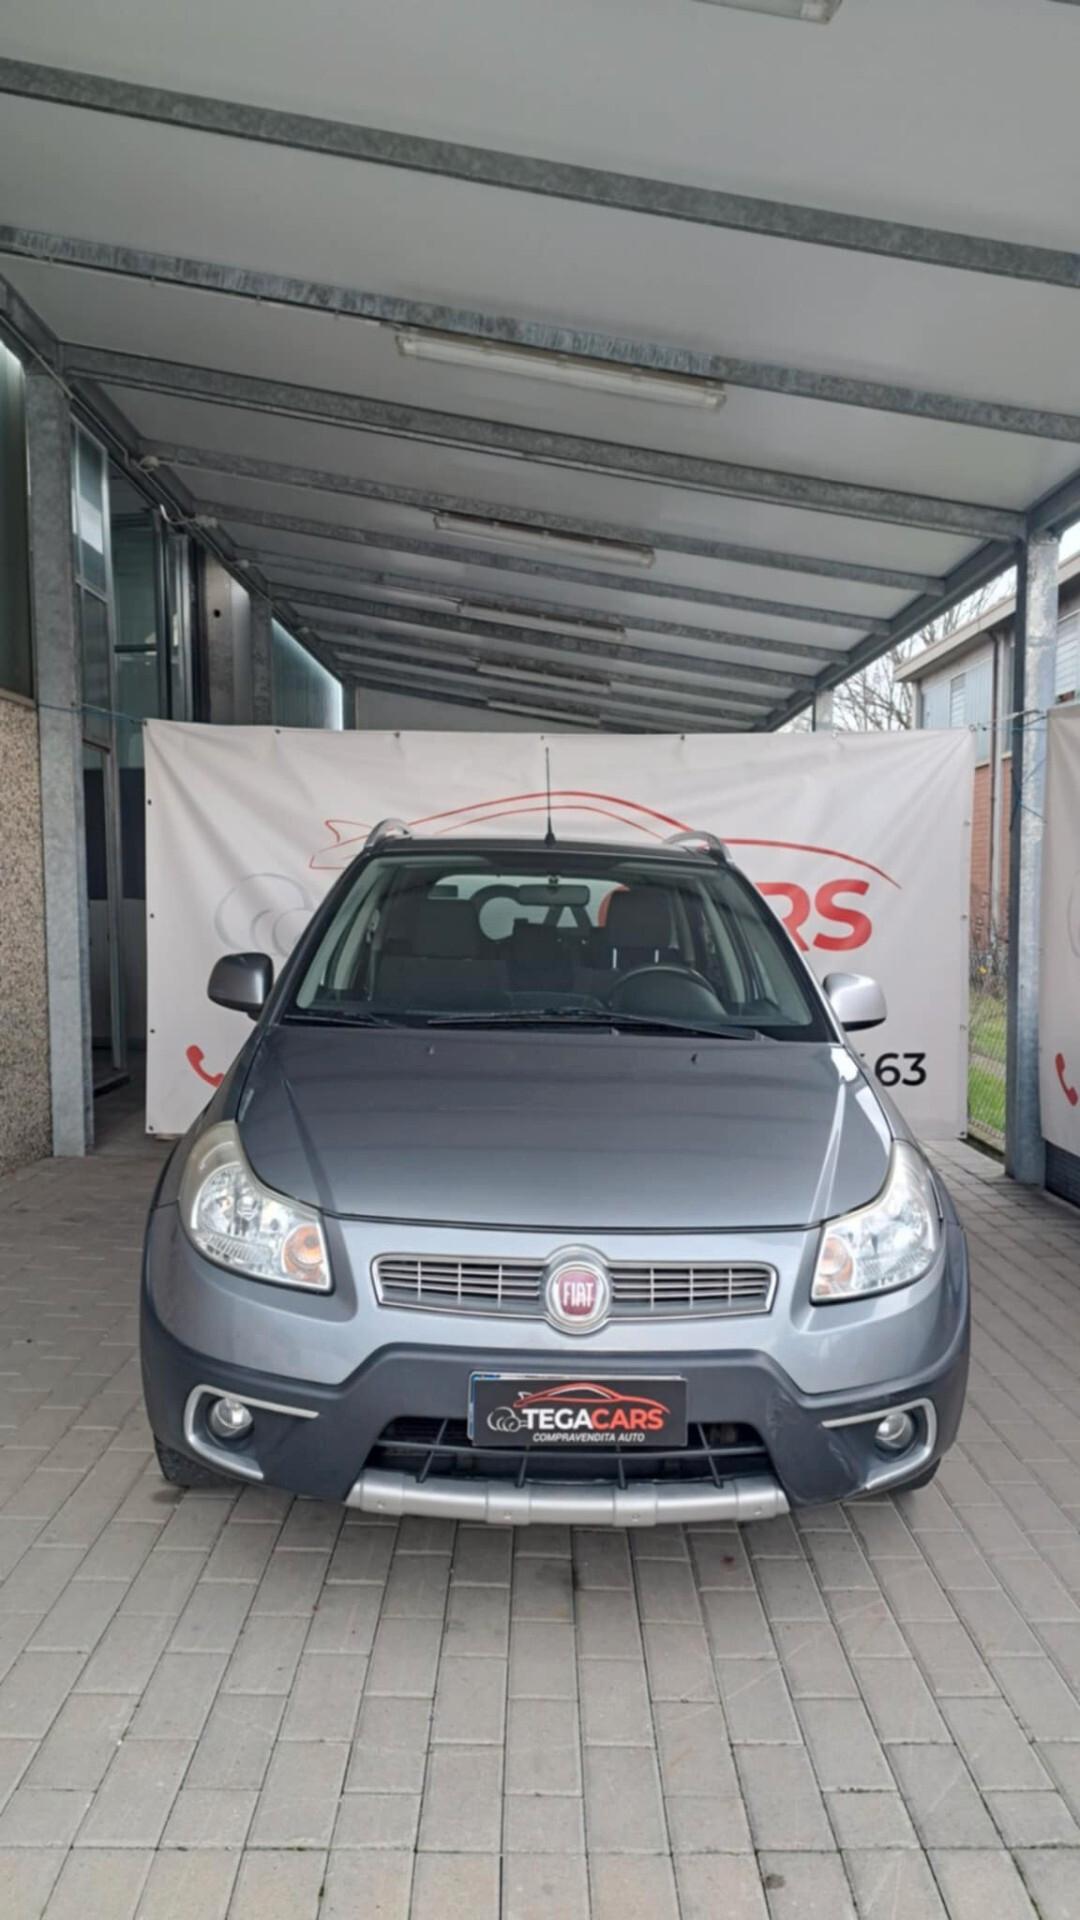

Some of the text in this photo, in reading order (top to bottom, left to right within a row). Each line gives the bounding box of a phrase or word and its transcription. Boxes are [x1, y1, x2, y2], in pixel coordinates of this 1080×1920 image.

[860, 1053, 926, 1087] 63
[563, 1281, 594, 1308] FIAT
[522, 1408, 664, 1431] TEGACARS
[533, 1432, 645, 1443] COMPRAVENDITA AUTO
